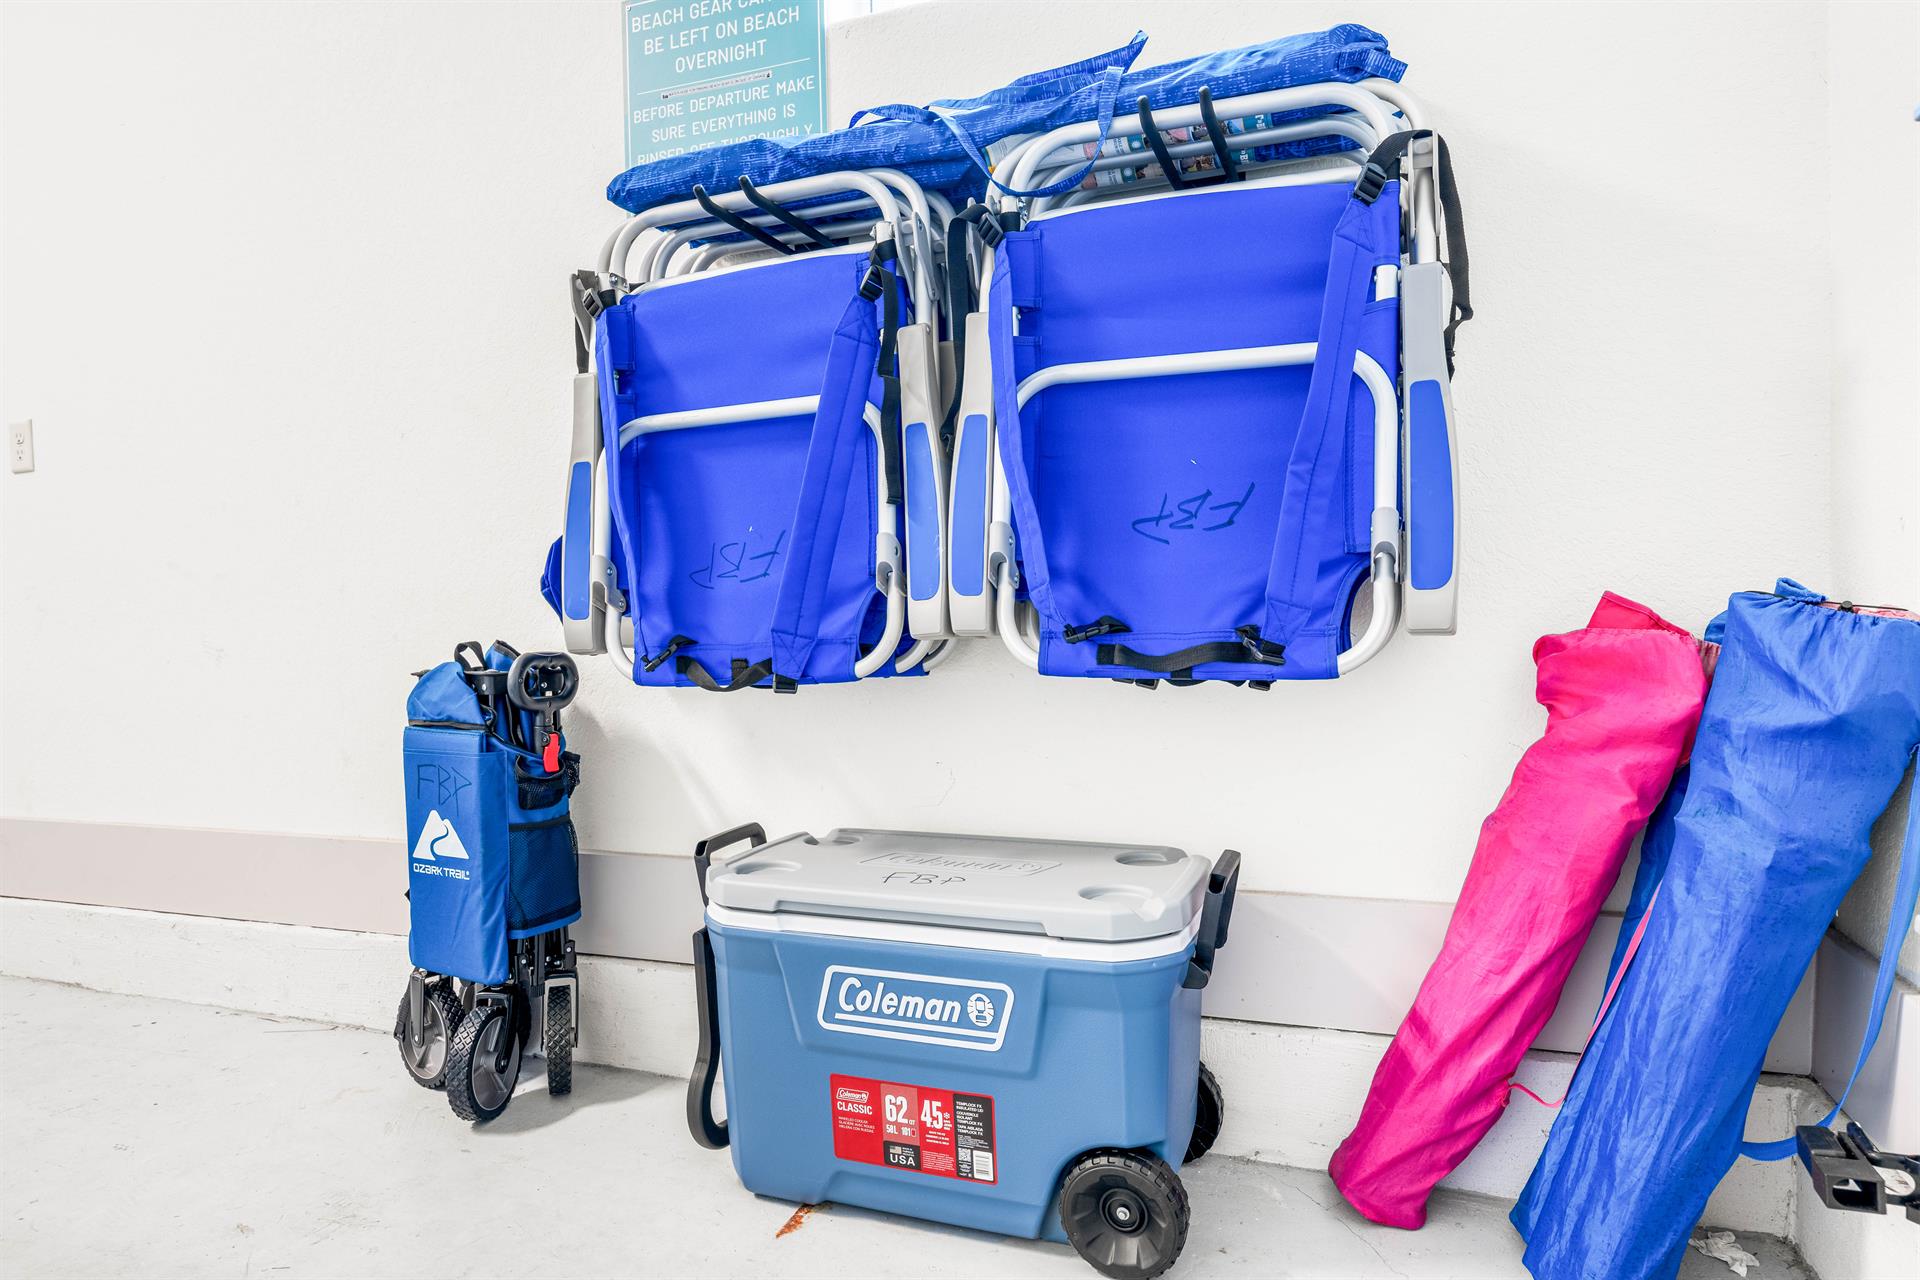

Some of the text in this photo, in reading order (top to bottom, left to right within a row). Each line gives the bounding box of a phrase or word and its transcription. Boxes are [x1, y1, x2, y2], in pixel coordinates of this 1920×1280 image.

[632, 0, 732, 33] BEACH GEAR
[644, 5, 800, 55] BE LEFT ON BEACH
[675, 39, 768, 73] OVERNIGHT
[633, 101, 684, 124] BEFORE
[690, 83, 770, 113] DEPARTURE
[776, 75, 816, 96] MAKE
[652, 104, 796, 143] SURE EVERYTHING IS
[688, 529, 786, 590] FBP
[417, 764, 473, 817] FBP
[882, 871, 966, 885] FBP
[838, 976, 962, 1023] Coleman
[837, 1102, 872, 1115] CLASSIC
[885, 1094, 908, 1124] 62
[890, 1154, 916, 1166] USA
